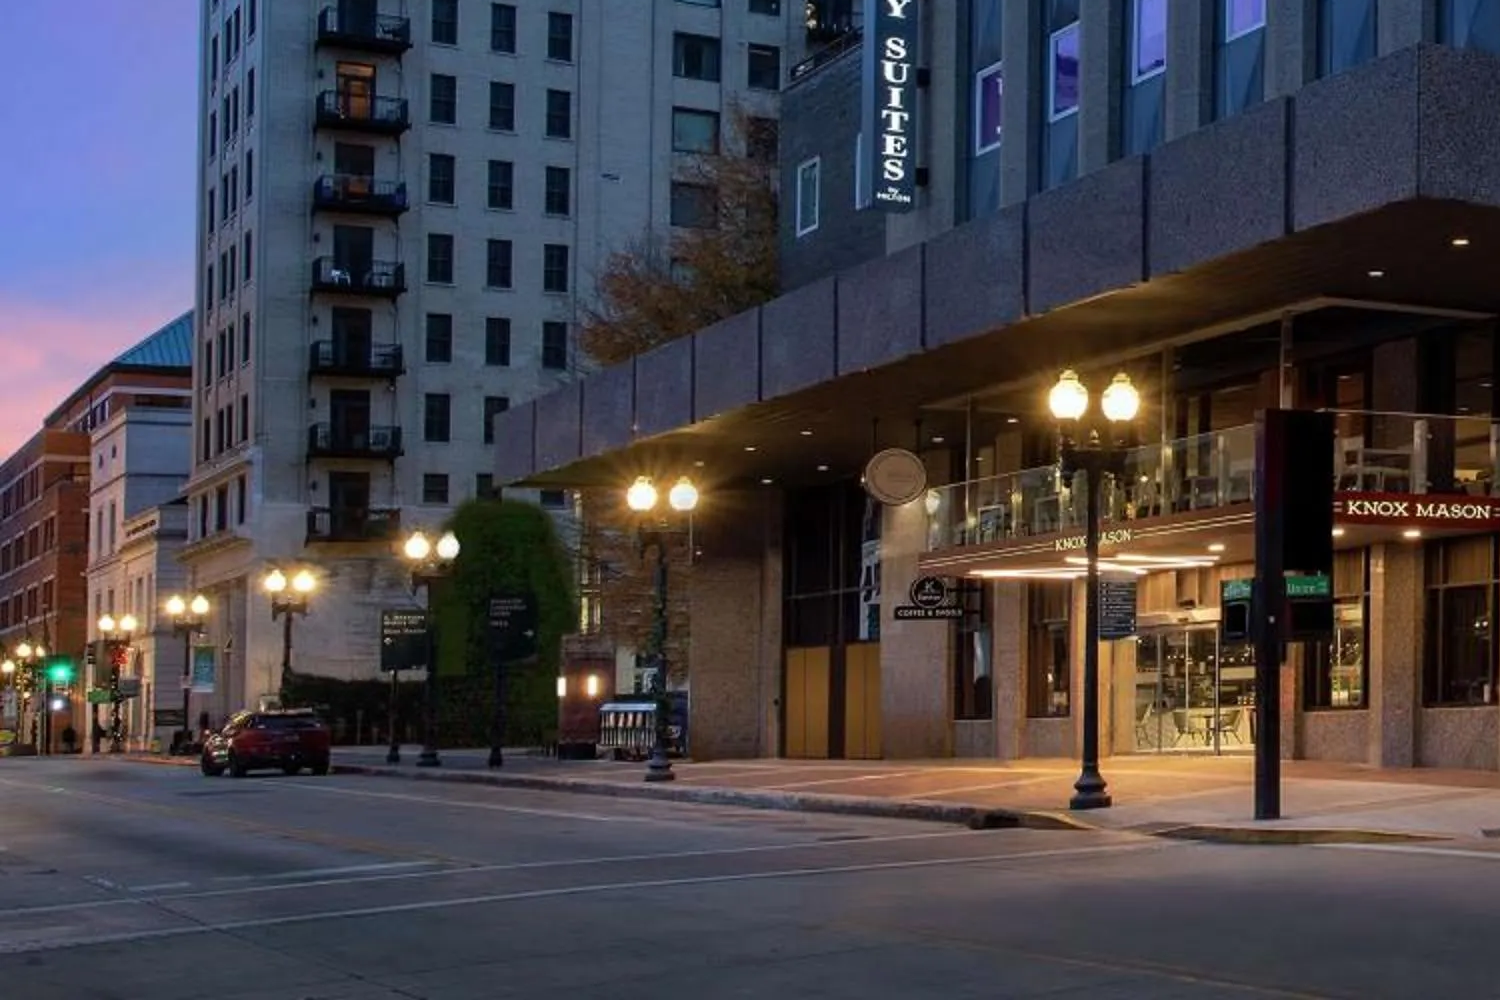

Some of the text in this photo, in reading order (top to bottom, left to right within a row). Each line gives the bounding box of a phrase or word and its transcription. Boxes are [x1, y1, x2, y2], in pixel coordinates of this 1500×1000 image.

[881, 37, 911, 181] SUITES
[1347, 500, 1492, 519] KNOX MASON
[1098, 528, 1132, 545] ASON
